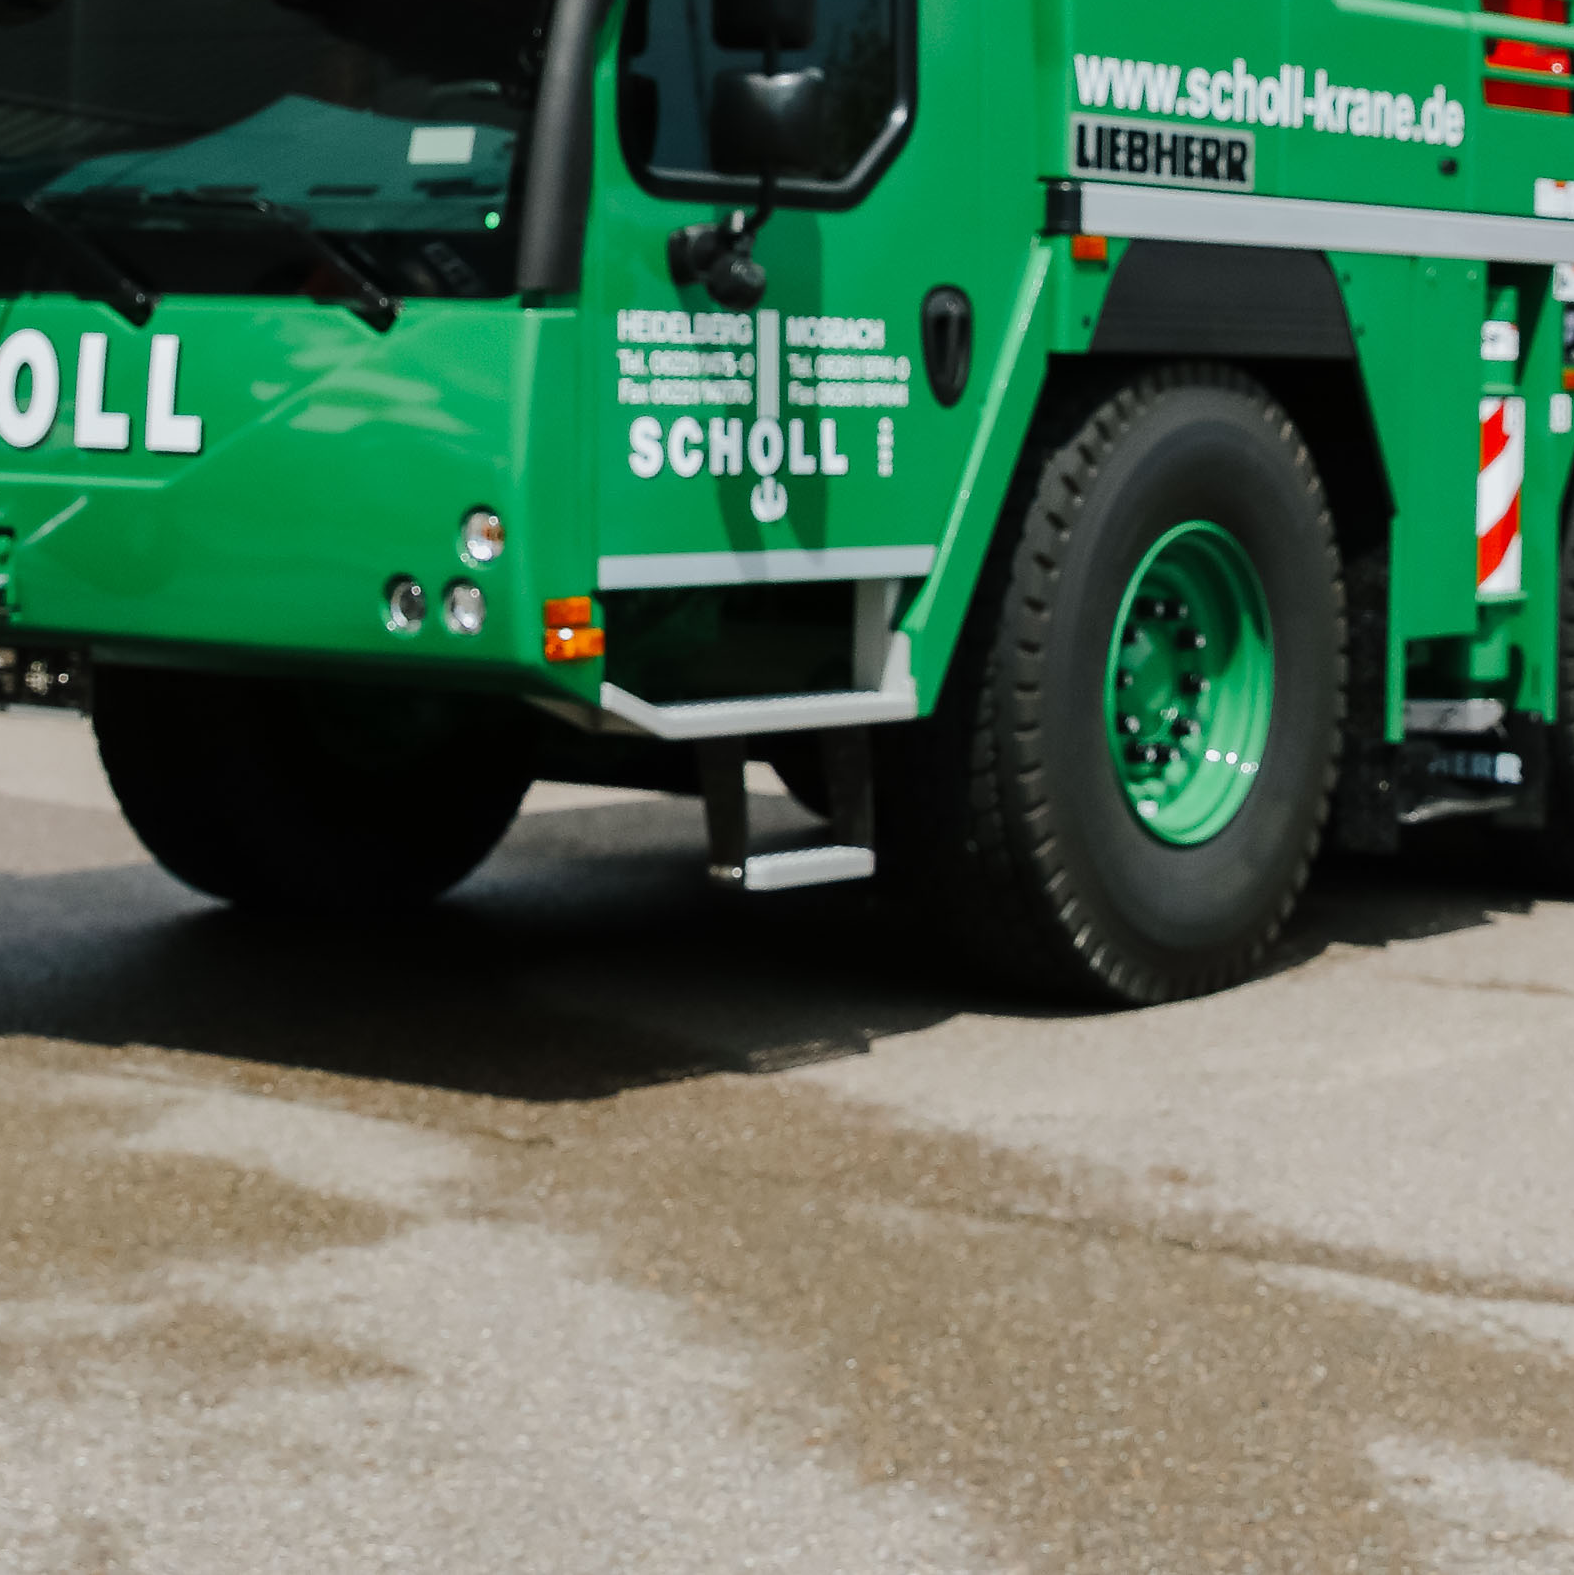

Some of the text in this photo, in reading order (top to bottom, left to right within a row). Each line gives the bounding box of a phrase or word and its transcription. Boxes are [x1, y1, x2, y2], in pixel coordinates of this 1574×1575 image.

[1073, 53, 1465, 147] www.scholl-krane.de
[1076, 124, 1248, 183] LIEBHERR
[628, 416, 848, 478] SCHOLL
